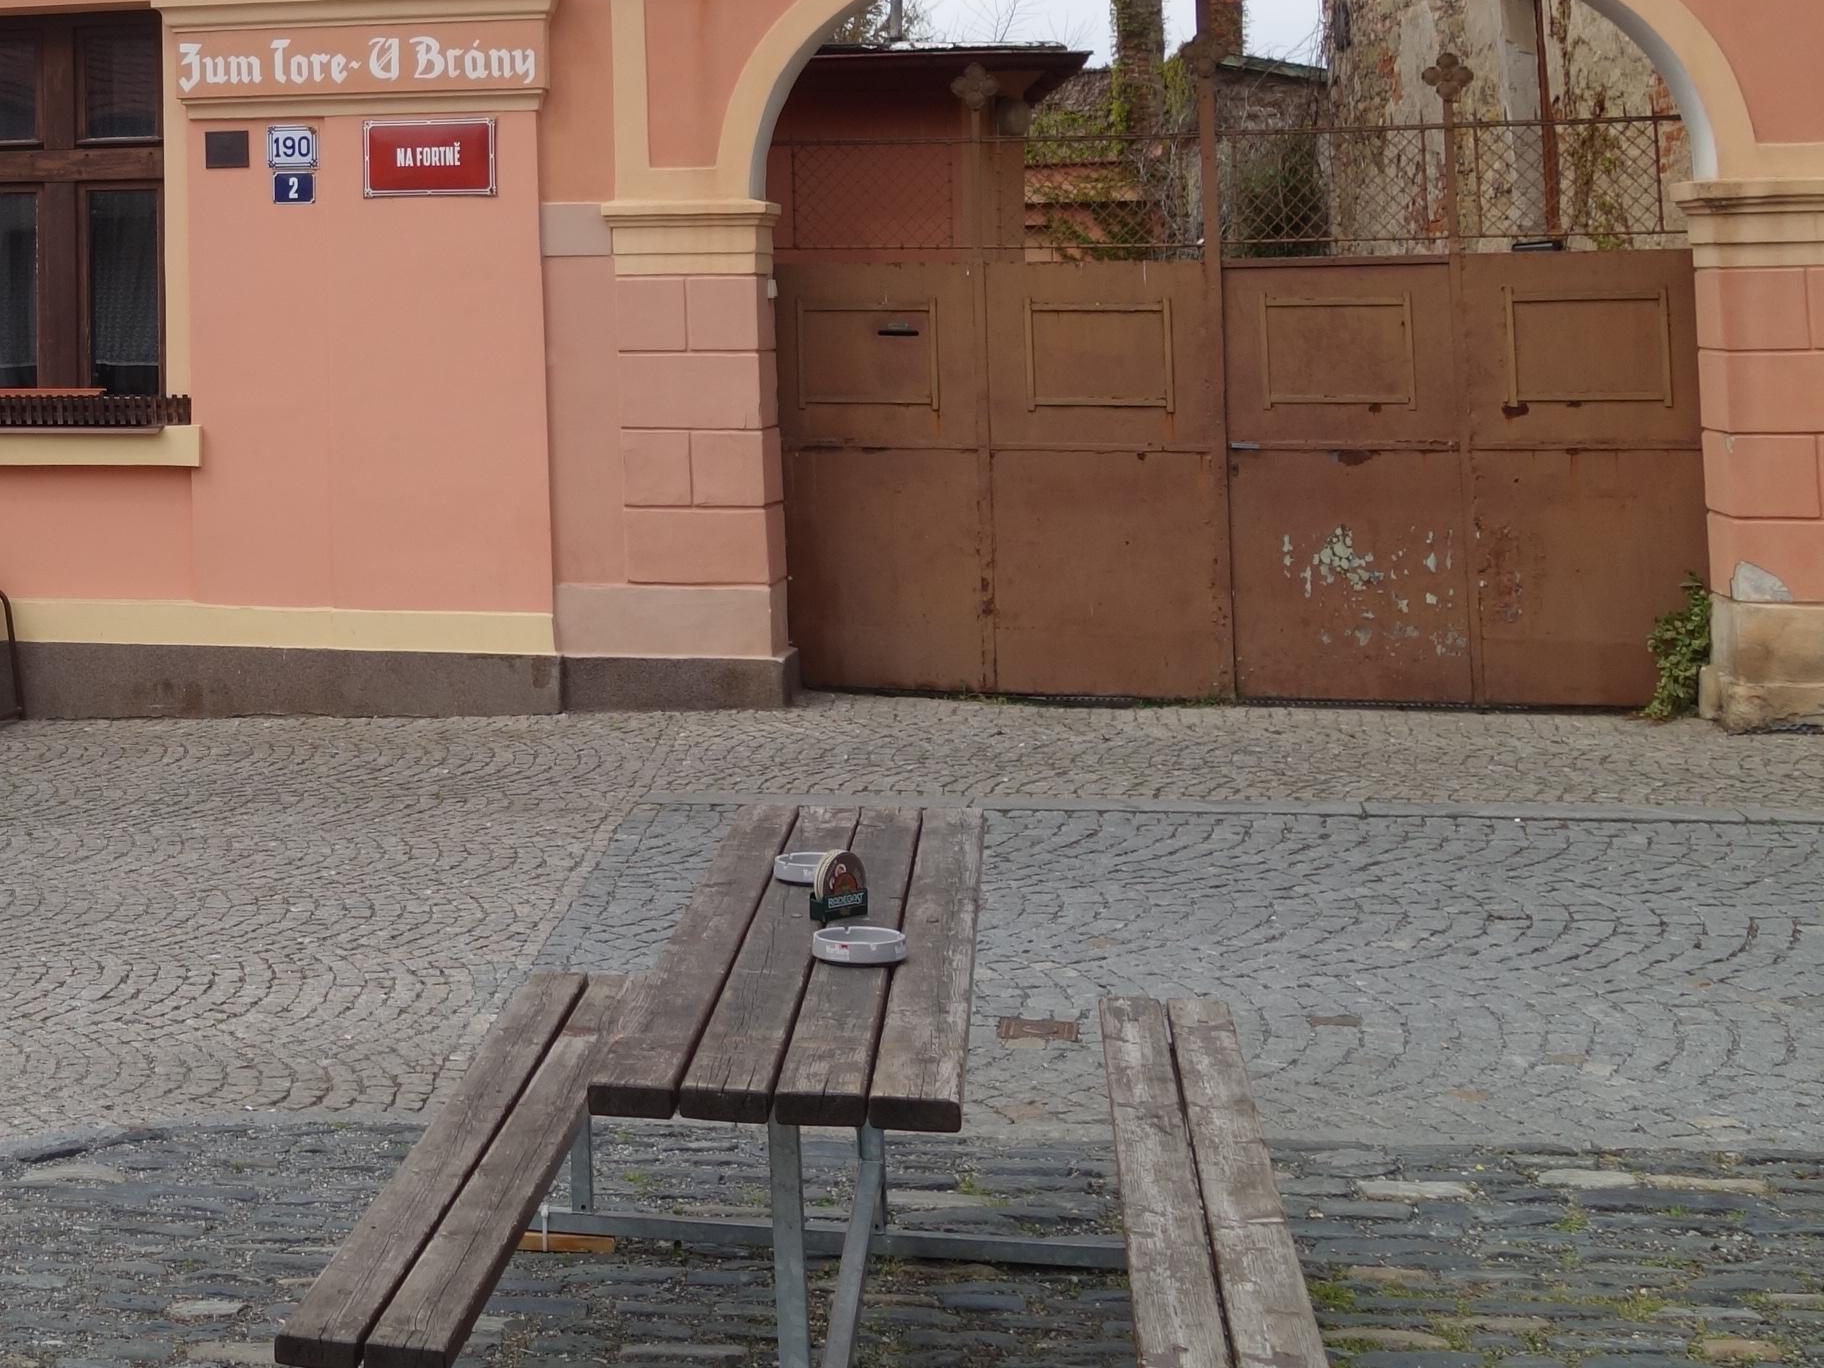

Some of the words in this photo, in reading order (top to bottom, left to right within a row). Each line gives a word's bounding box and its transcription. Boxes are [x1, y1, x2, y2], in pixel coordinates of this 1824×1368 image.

[409, 36, 535, 84] Brány
[274, 136, 311, 159] 190
[397, 147, 414, 167] NA
[416, 141, 461, 166] FORTNĚ
[288, 177, 299, 198] 2
[828, 892, 864, 908] RADEGAST
